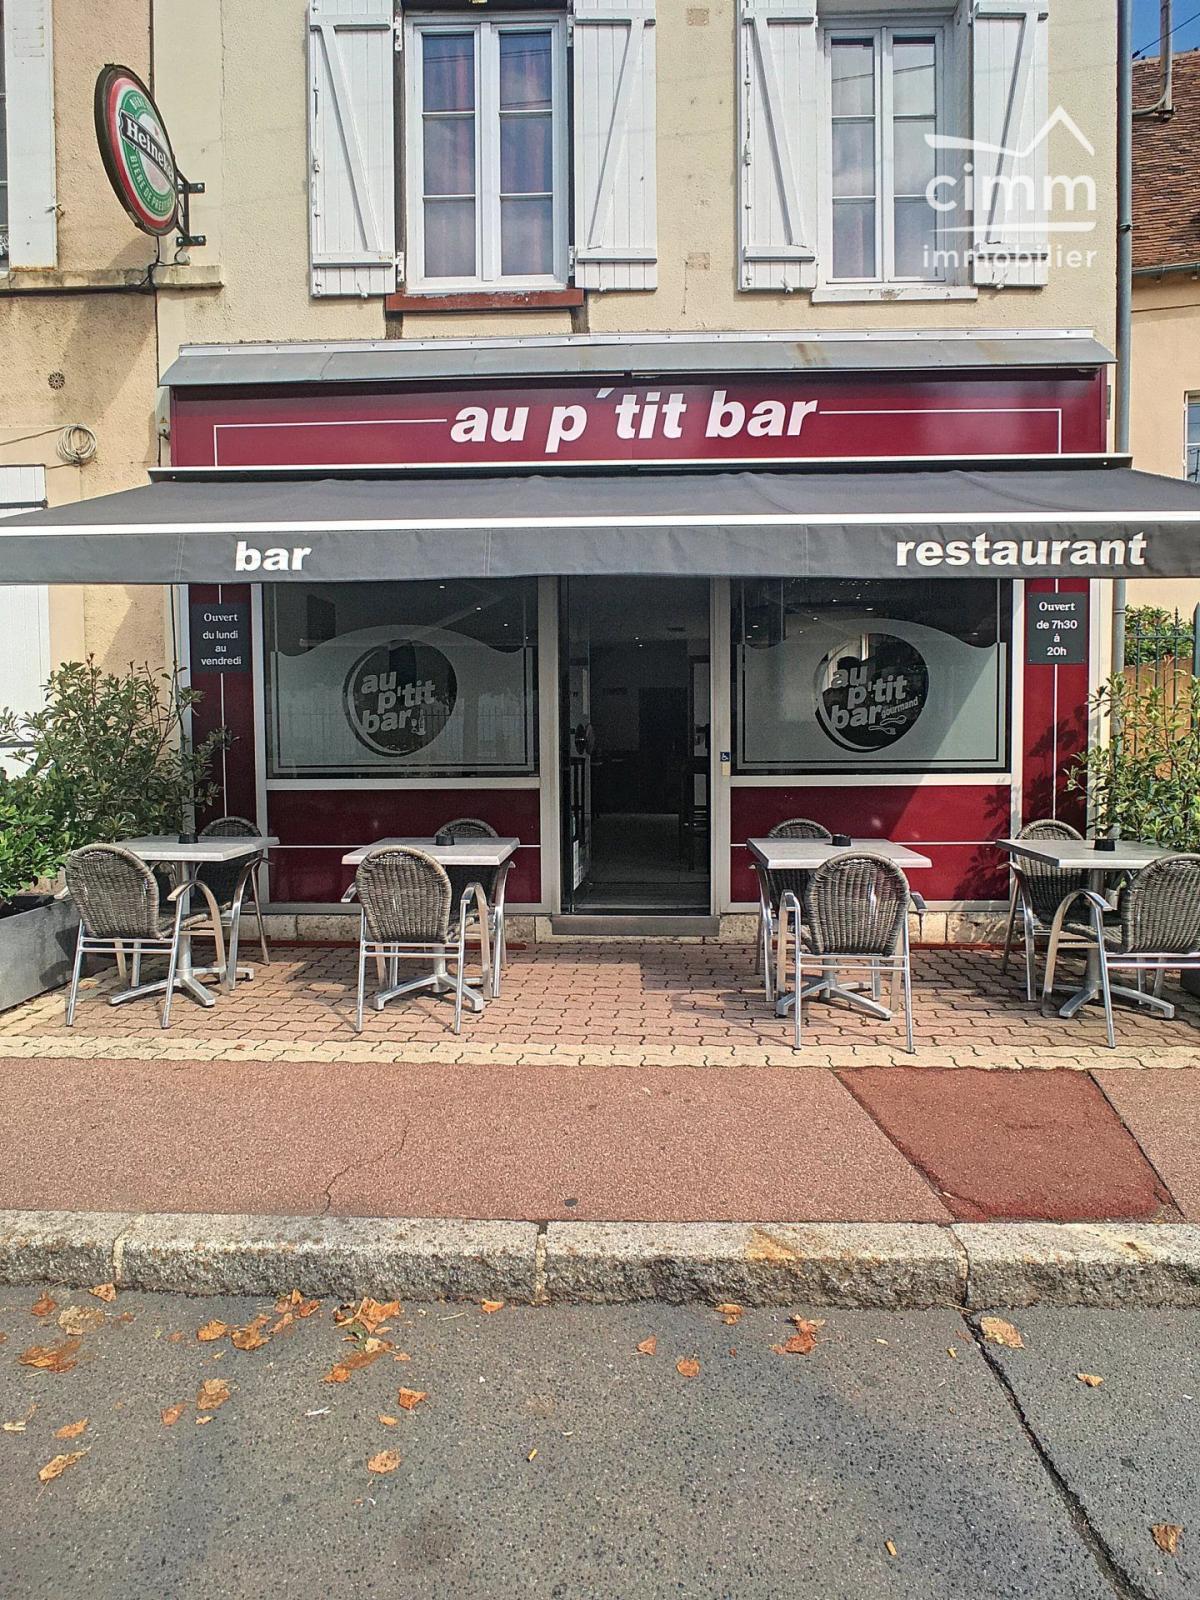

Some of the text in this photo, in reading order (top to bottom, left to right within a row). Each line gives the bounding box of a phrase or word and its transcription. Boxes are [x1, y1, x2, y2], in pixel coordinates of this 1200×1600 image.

[450, 405, 530, 442] au
[705, 390, 818, 438] bar
[235, 541, 312, 571] bar
[896, 532, 1147, 566] restaurant
[203, 612, 238, 622] Ouvert
[1038, 601, 1076, 611] Ouvert
[202, 630, 239, 639] du lundi
[1036, 620, 1078, 629] de 7h30
[215, 645, 227, 653] au
[1046, 647, 1067, 656] 20h
[201, 656, 242, 666] vendredi
[361, 672, 397, 694] au
[831, 666, 868, 688] au
[377, 680, 435, 714] p'tit
[847, 675, 908, 709] p'tit
[361, 710, 412, 733] bar
[830, 696, 919, 729] bar gourmand
